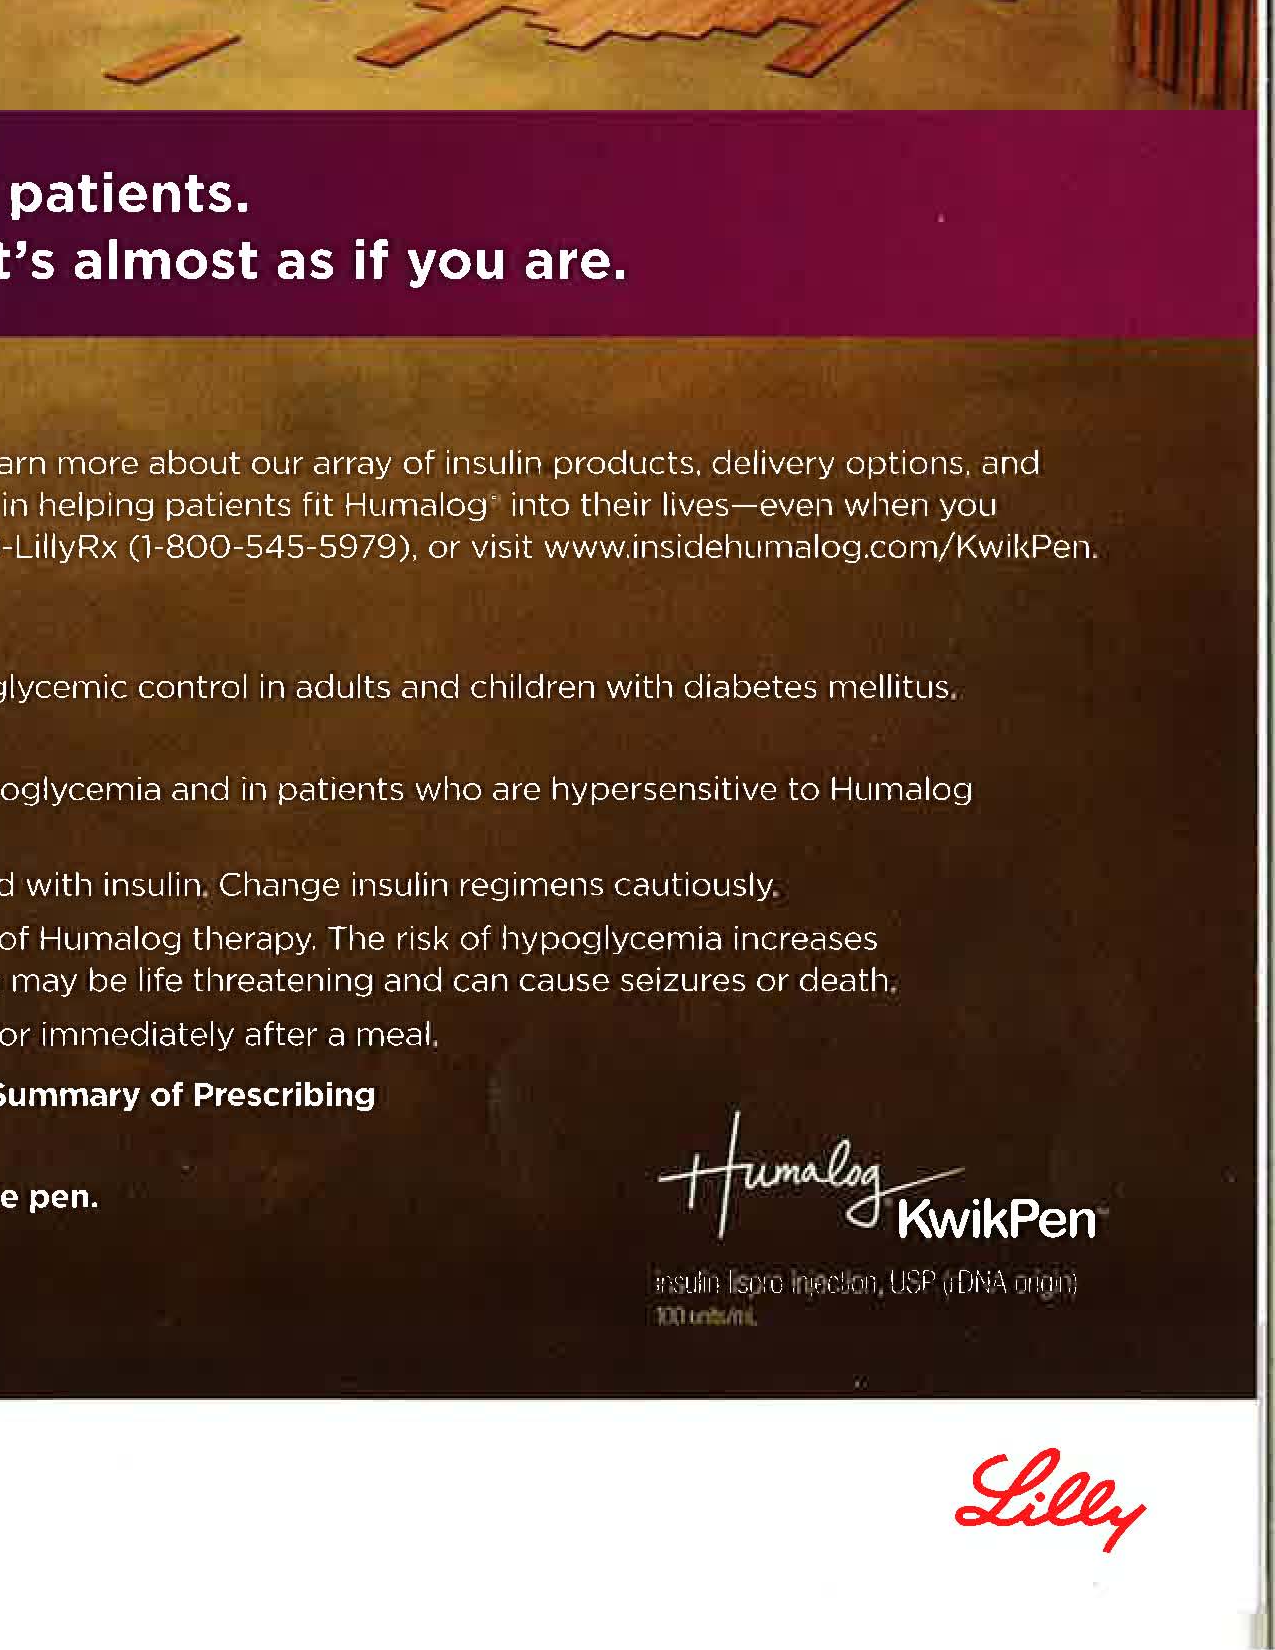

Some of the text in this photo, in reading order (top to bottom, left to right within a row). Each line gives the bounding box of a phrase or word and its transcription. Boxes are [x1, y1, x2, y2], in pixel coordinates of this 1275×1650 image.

[10, 171, 248, 221] patients.
[74, 238, 258, 280] almost
[277, 248, 334, 280] as
[355, 238, 389, 280] if
[407, 248, 504, 289] you
[525, 248, 625, 280] are.
[58, 456, 139, 475] more
[149, 449, 241, 475] about
[251, 456, 304, 475] our
[313, 456, 392, 480] array
[403, 449, 436, 475] of
[446, 449, 542, 475] insulin
[554, 449, 701, 480] products,
[712, 449, 835, 480] delivery
[846, 449, 970, 480] options,
[982, 449, 1039, 475] and
[129, 533, 417, 563] (1-800-545-5979),
[428, 540, 461, 559] or
[471, 533, 533, 559] visit
[544, 531, 1098, 564] www.insidehumalog.com/KwikPen.
[138, 673, 247, 699] control
[260, 673, 285, 699] in
[296, 673, 391, 699] adults
[401, 673, 459, 699] and
[470, 673, 595, 699] children
[606, 673, 673, 699] with
[684, 673, 817, 699] diabetes
[829, 673, 956, 700] mellitus.
[26, 871, 92, 897] with
[104, 871, 208, 897] insulin.
[219, 870, 340, 902] Change
[352, 871, 448, 897] insulin
[460, 877, 604, 902] regimens
[614, 871, 778, 902] cautiously.
[40, 925, 181, 956] Humalog
[192, 925, 316, 956] therapy.
[327, 924, 385, 951] The
[397, 925, 449, 951] risk
[460, 924, 492, 951] of
[502, 924, 722, 956] hypoglycemia
[734, 925, 878, 951] increases
[150, 1081, 184, 1107] of
[194, 1081, 375, 1112] Prescribing
[658, 1109, 966, 1240] Humalog
[29, 1189, 98, 1214] pen.
[898, 1197, 1097, 1239] KwikPen
[655, 1269, 720, 1294] insulin
[890, 1269, 936, 1294] USP
[954, 1447, 1148, 1554] Lilly
